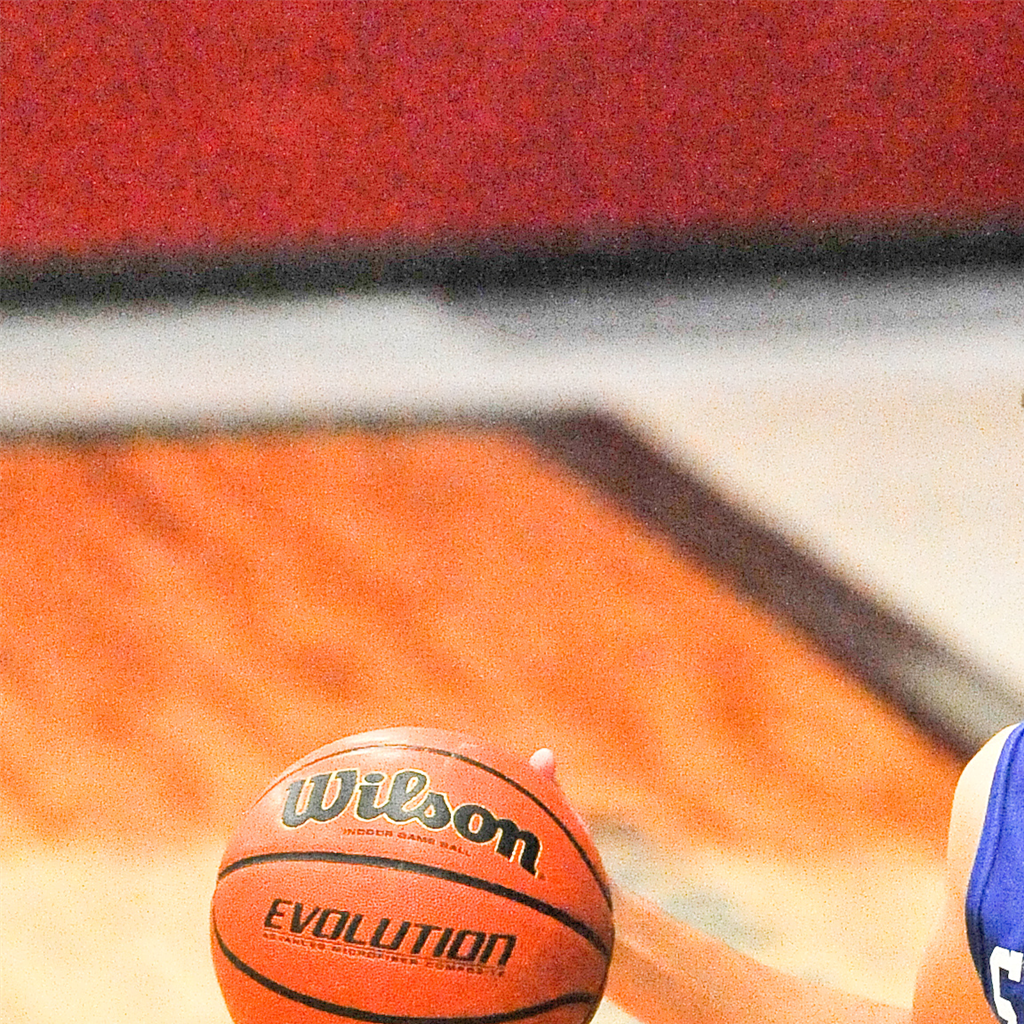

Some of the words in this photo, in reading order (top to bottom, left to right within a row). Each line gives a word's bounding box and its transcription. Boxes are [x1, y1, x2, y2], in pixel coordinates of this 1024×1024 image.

[281, 768, 542, 878] Wilson
[397, 832, 436, 845] GAME
[263, 898, 517, 967] EVOLUTION
